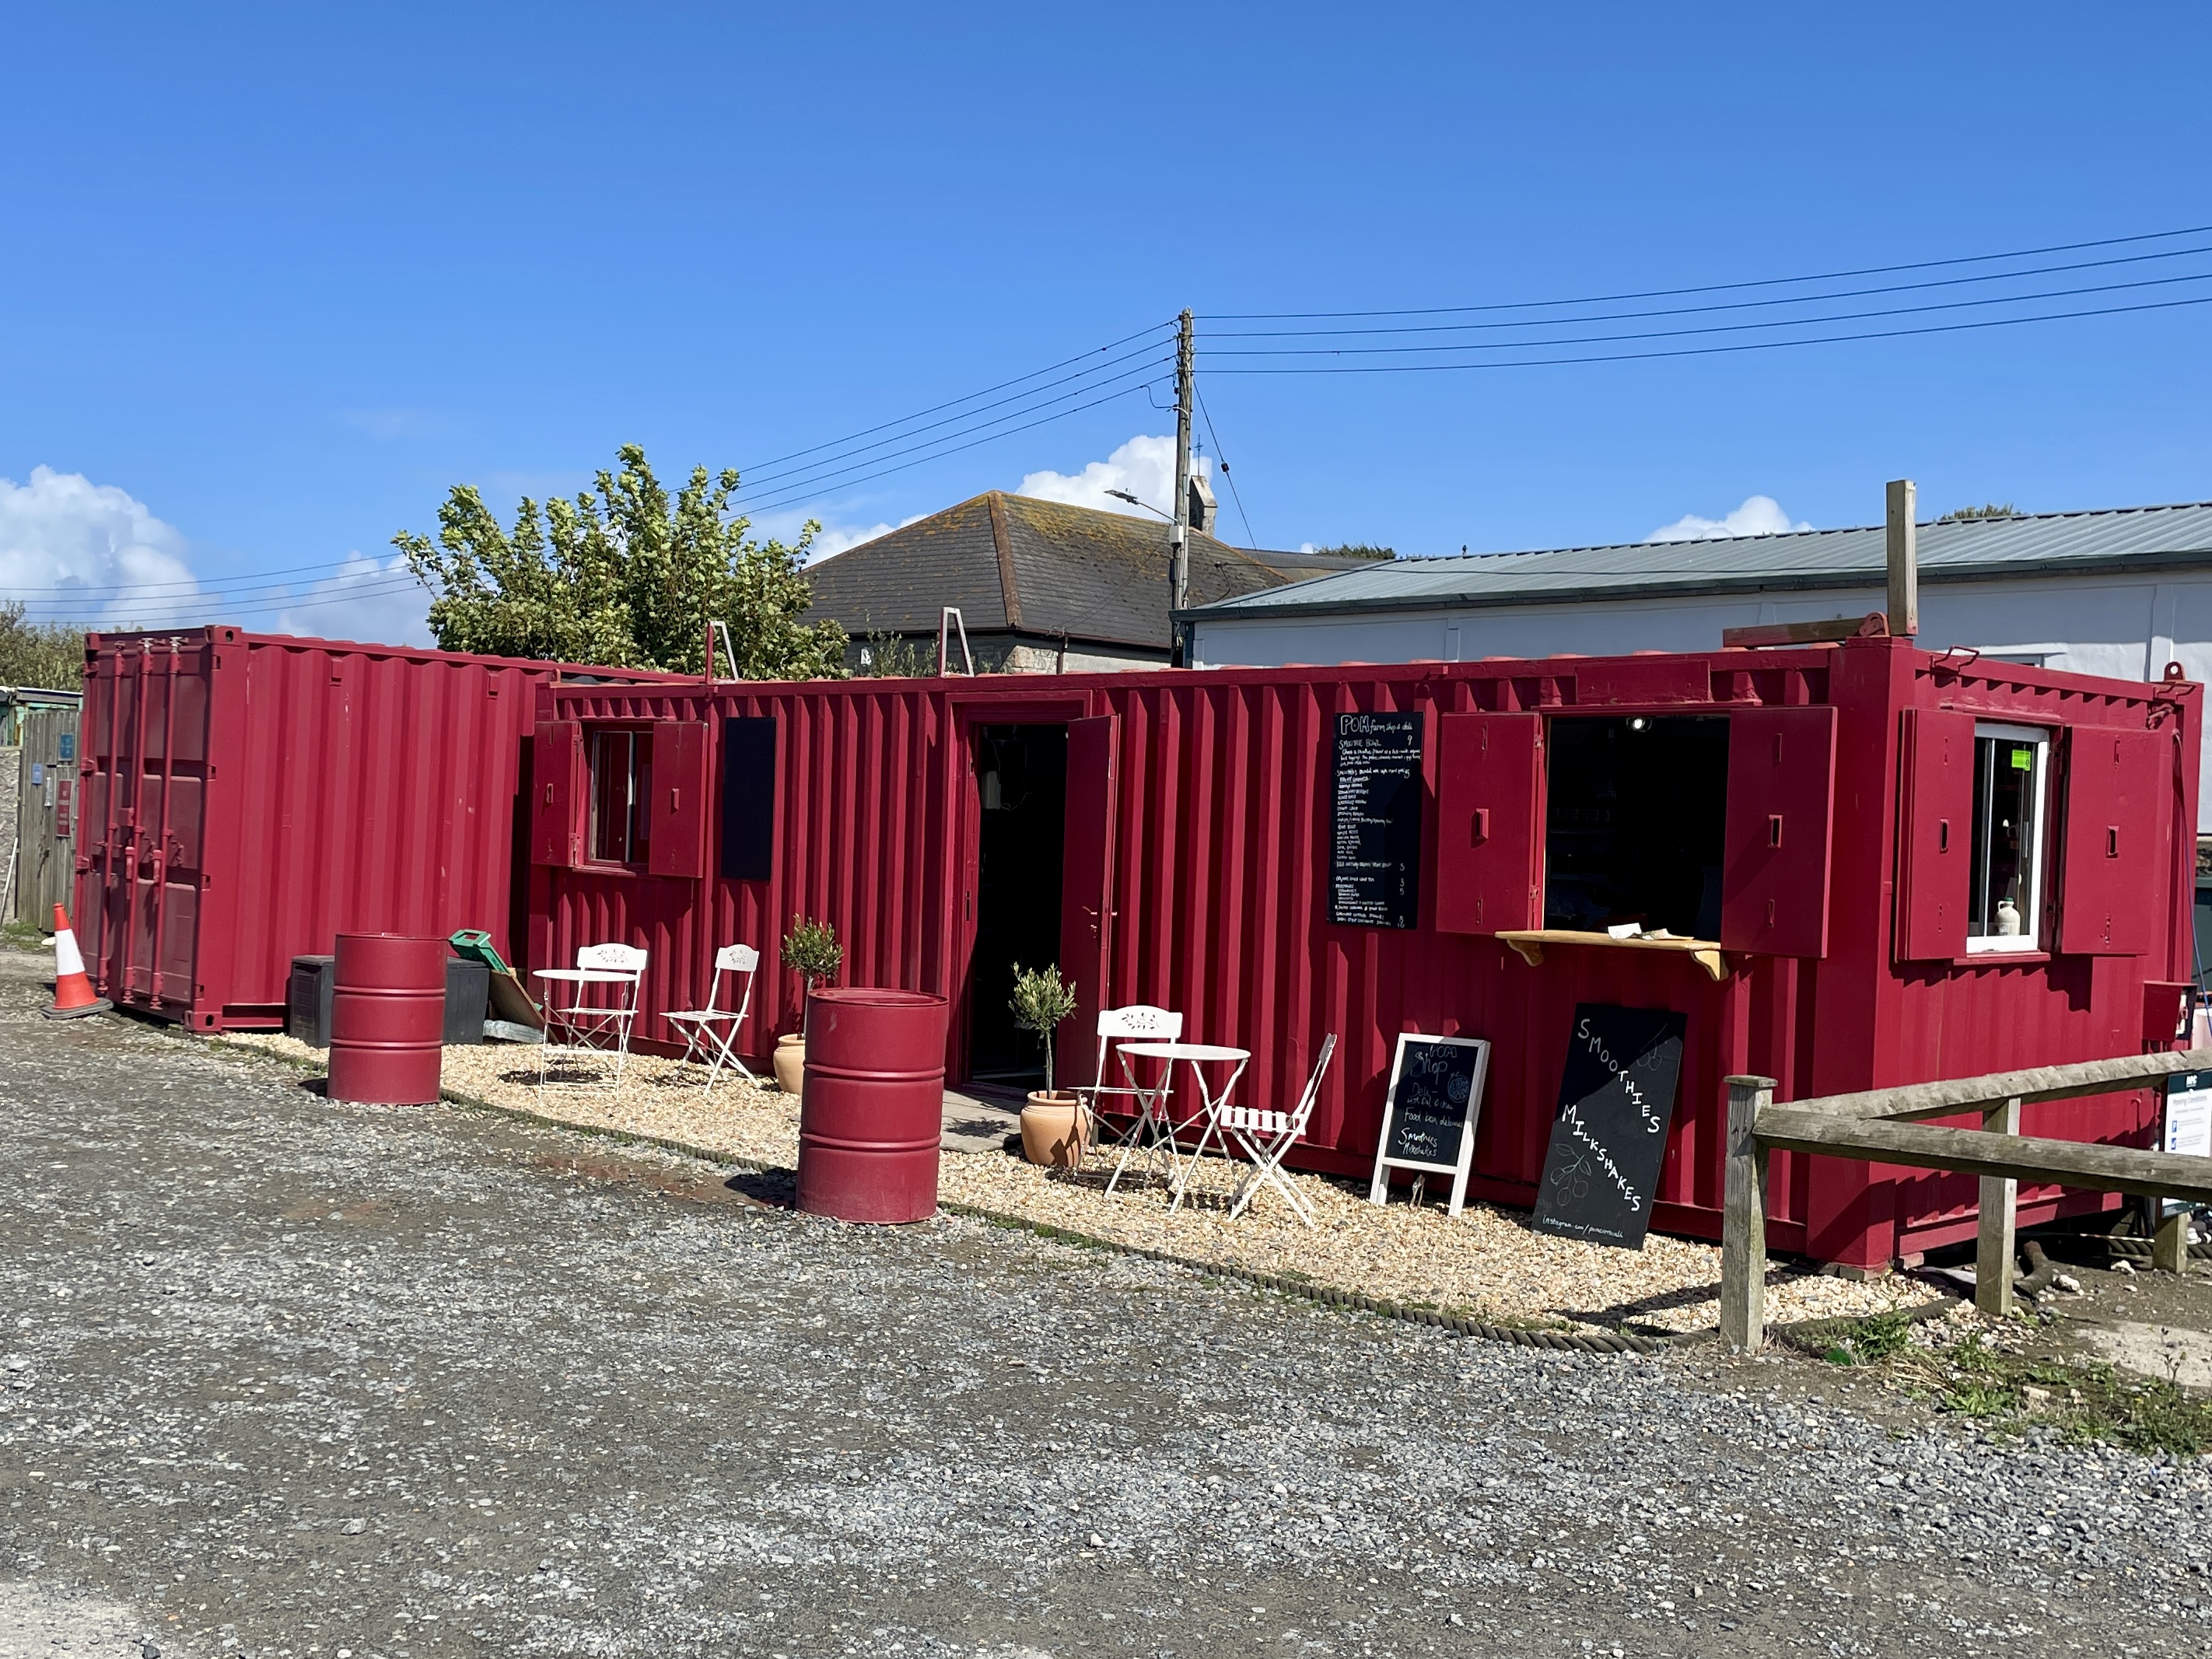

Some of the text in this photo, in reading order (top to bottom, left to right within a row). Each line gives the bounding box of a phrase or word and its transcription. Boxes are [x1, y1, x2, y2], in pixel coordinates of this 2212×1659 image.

[1341, 715, 1370, 735] POM
[1370, 719, 1385, 734] farm
[1407, 735, 1412, 746] 9
[1400, 863, 1405, 871] 5
[1399, 877, 1405, 887] 3
[1430, 1045, 1458, 1058] POM
[1409, 1052, 1448, 1085] Shop
[1577, 1019, 1661, 1133] SMOOTHIES
[1404, 1107, 1422, 1122] Food
[1562, 1104, 1641, 1211] MILKSHAKES
